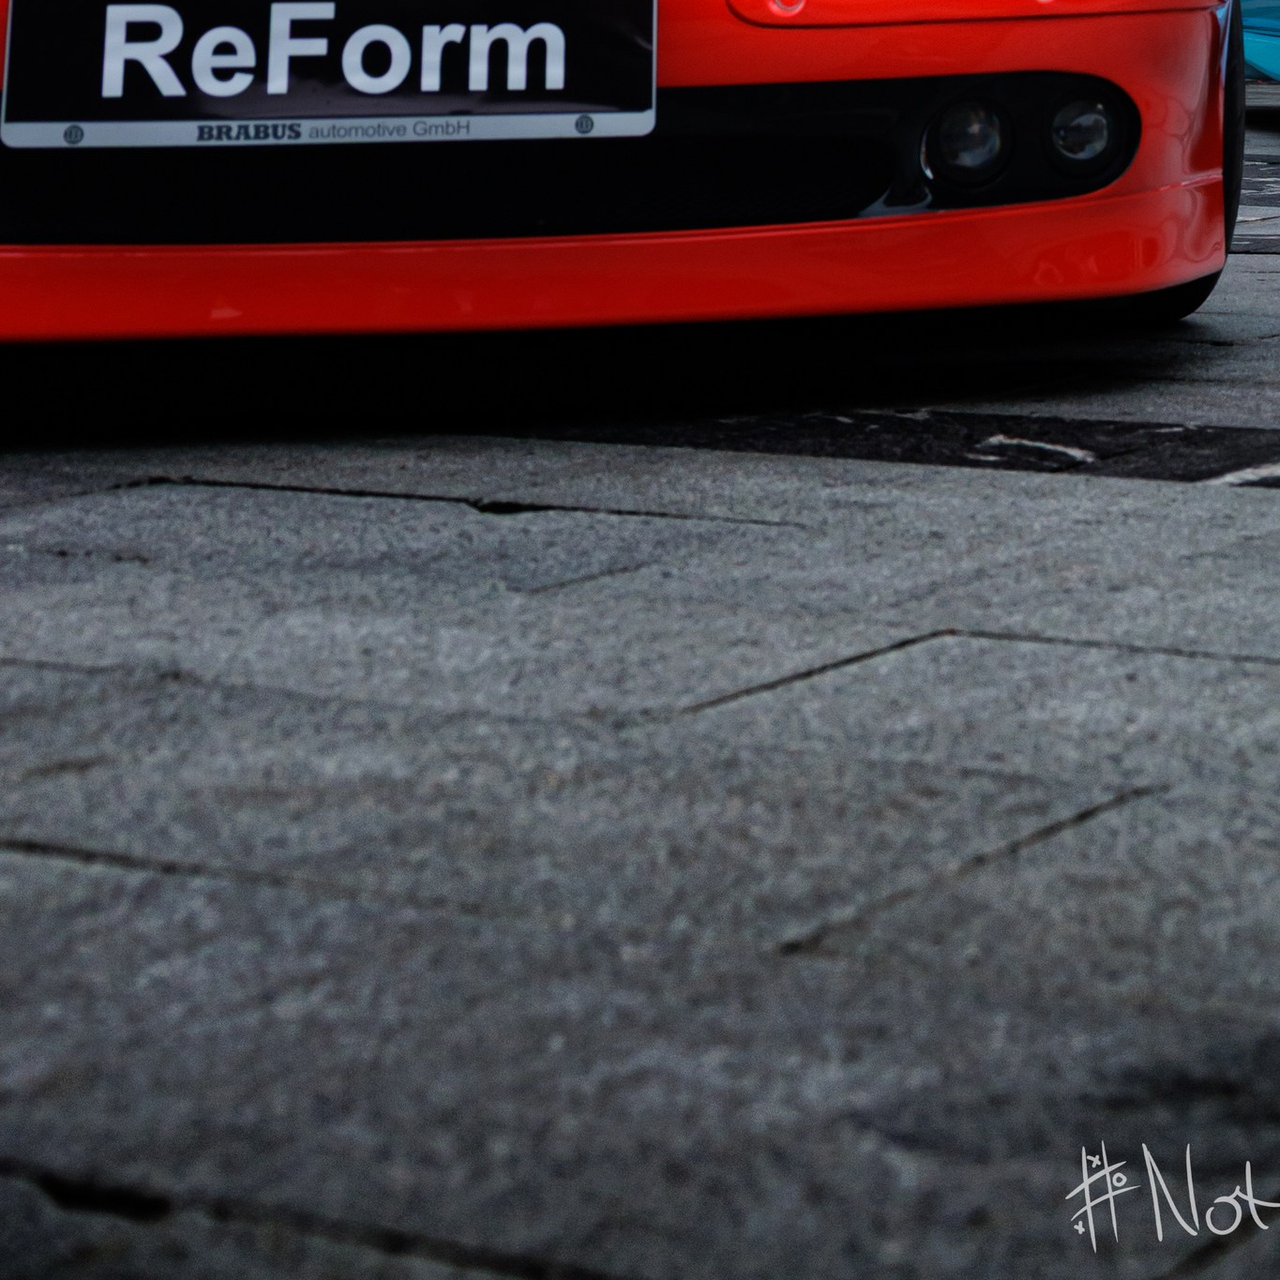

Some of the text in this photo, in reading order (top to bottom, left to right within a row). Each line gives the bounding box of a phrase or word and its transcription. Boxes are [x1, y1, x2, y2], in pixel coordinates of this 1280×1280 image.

[101, 1, 566, 98] ReForm
[196, 120, 470, 142] BRABUS automotive GmbH
